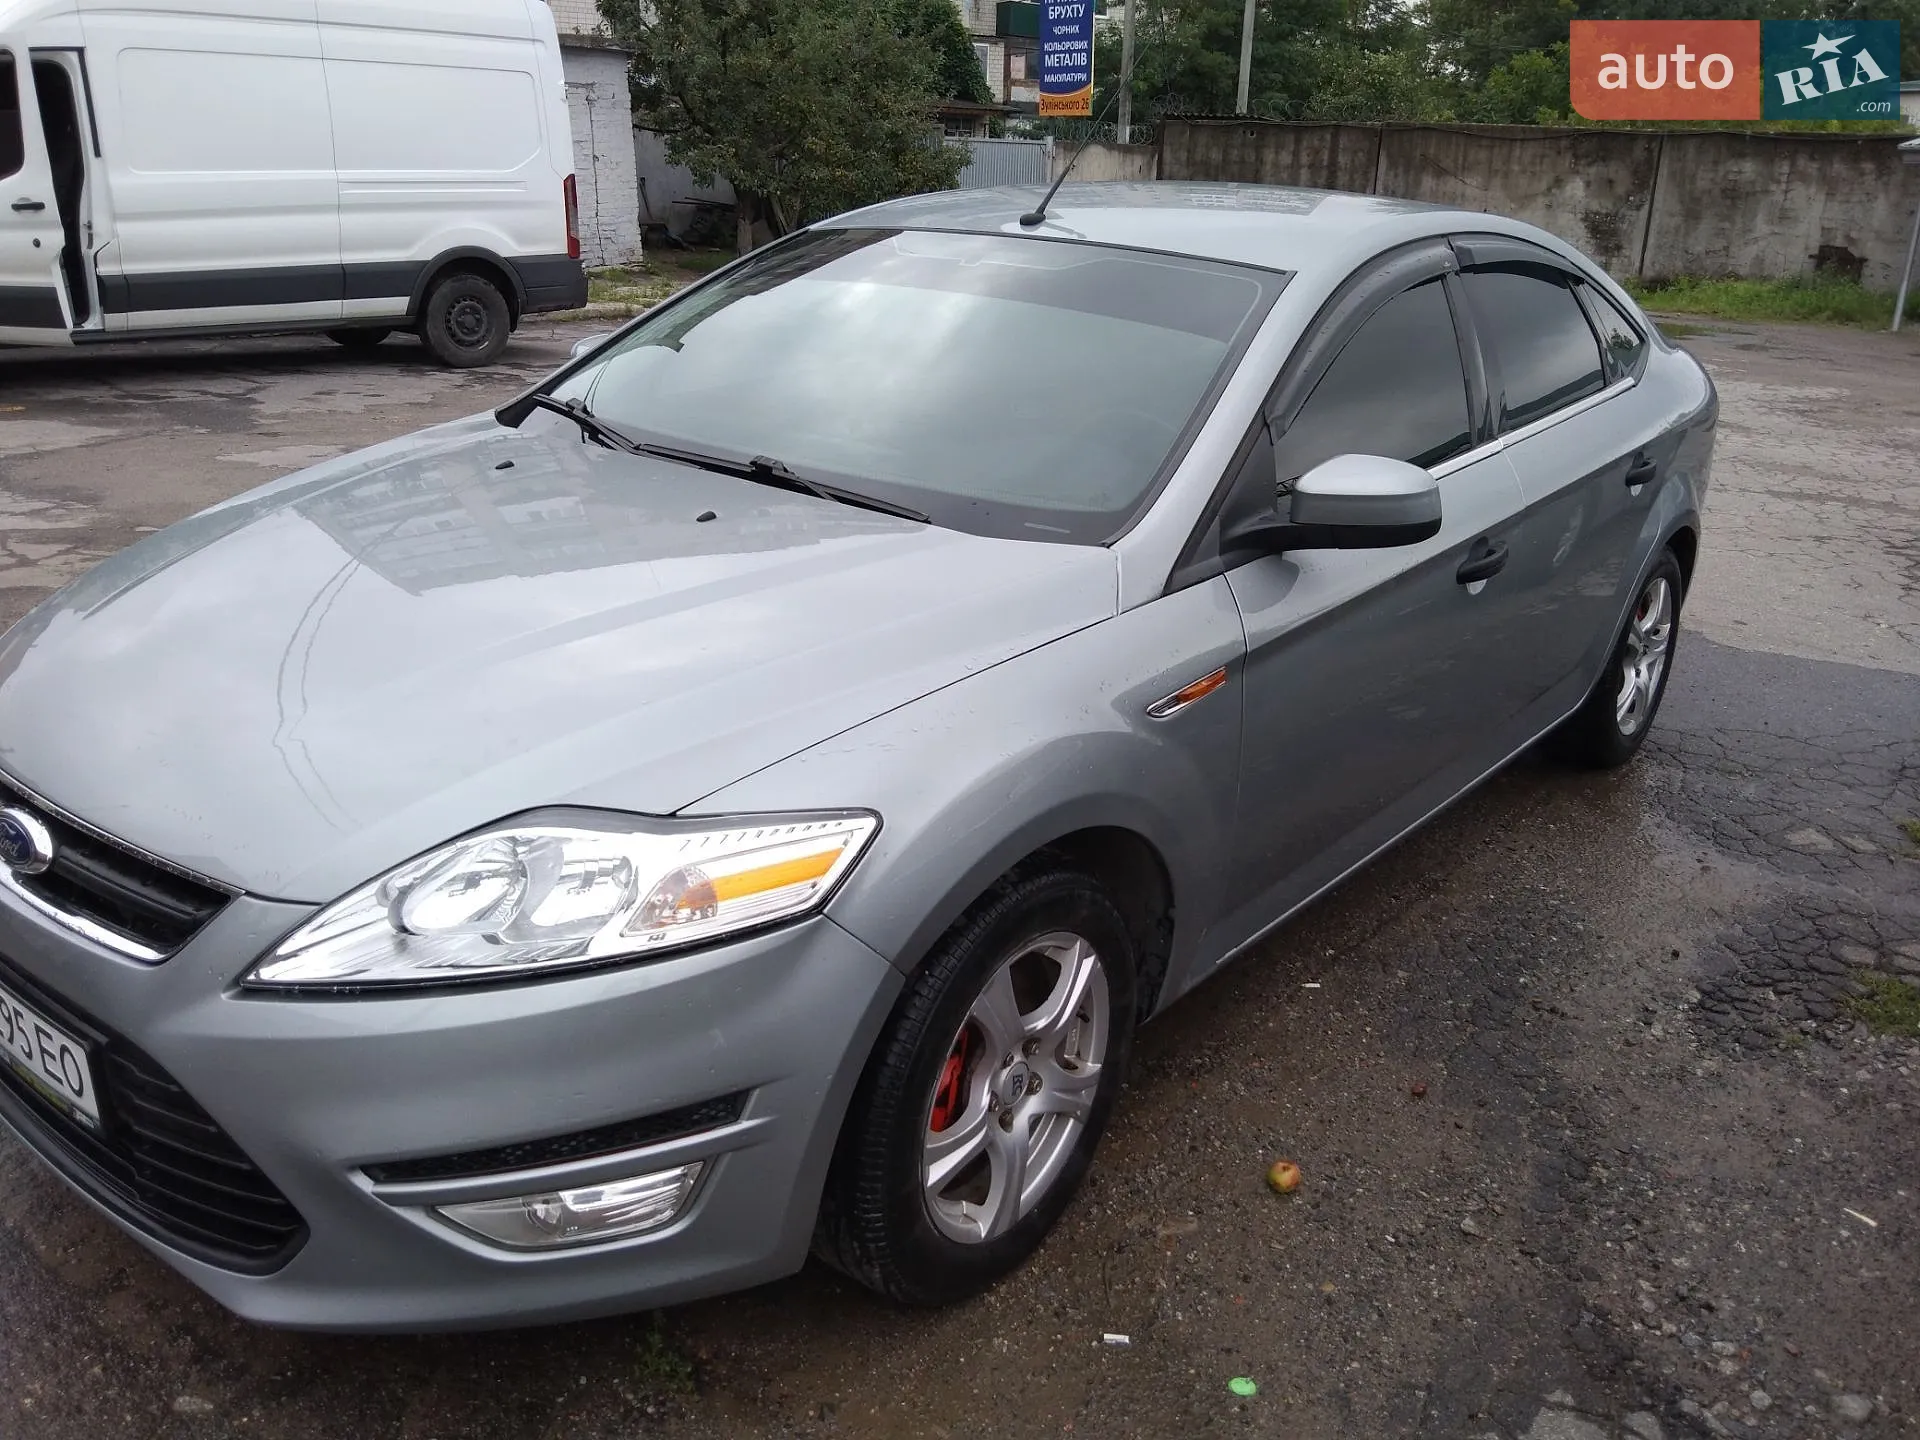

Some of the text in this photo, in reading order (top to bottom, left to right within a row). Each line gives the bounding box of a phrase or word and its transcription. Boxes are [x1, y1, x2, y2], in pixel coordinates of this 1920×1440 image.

[1048, 4, 1085, 20] БРУХТУ
[1052, 24, 1080, 35] ЧОРНИХ
[1044, 40, 1088, 52] КОЛЬОРОВИХ
[1044, 52, 1087, 68] МЕТАЛІВ
[1044, 73, 1087, 83] МАКУЛАТУРИ
